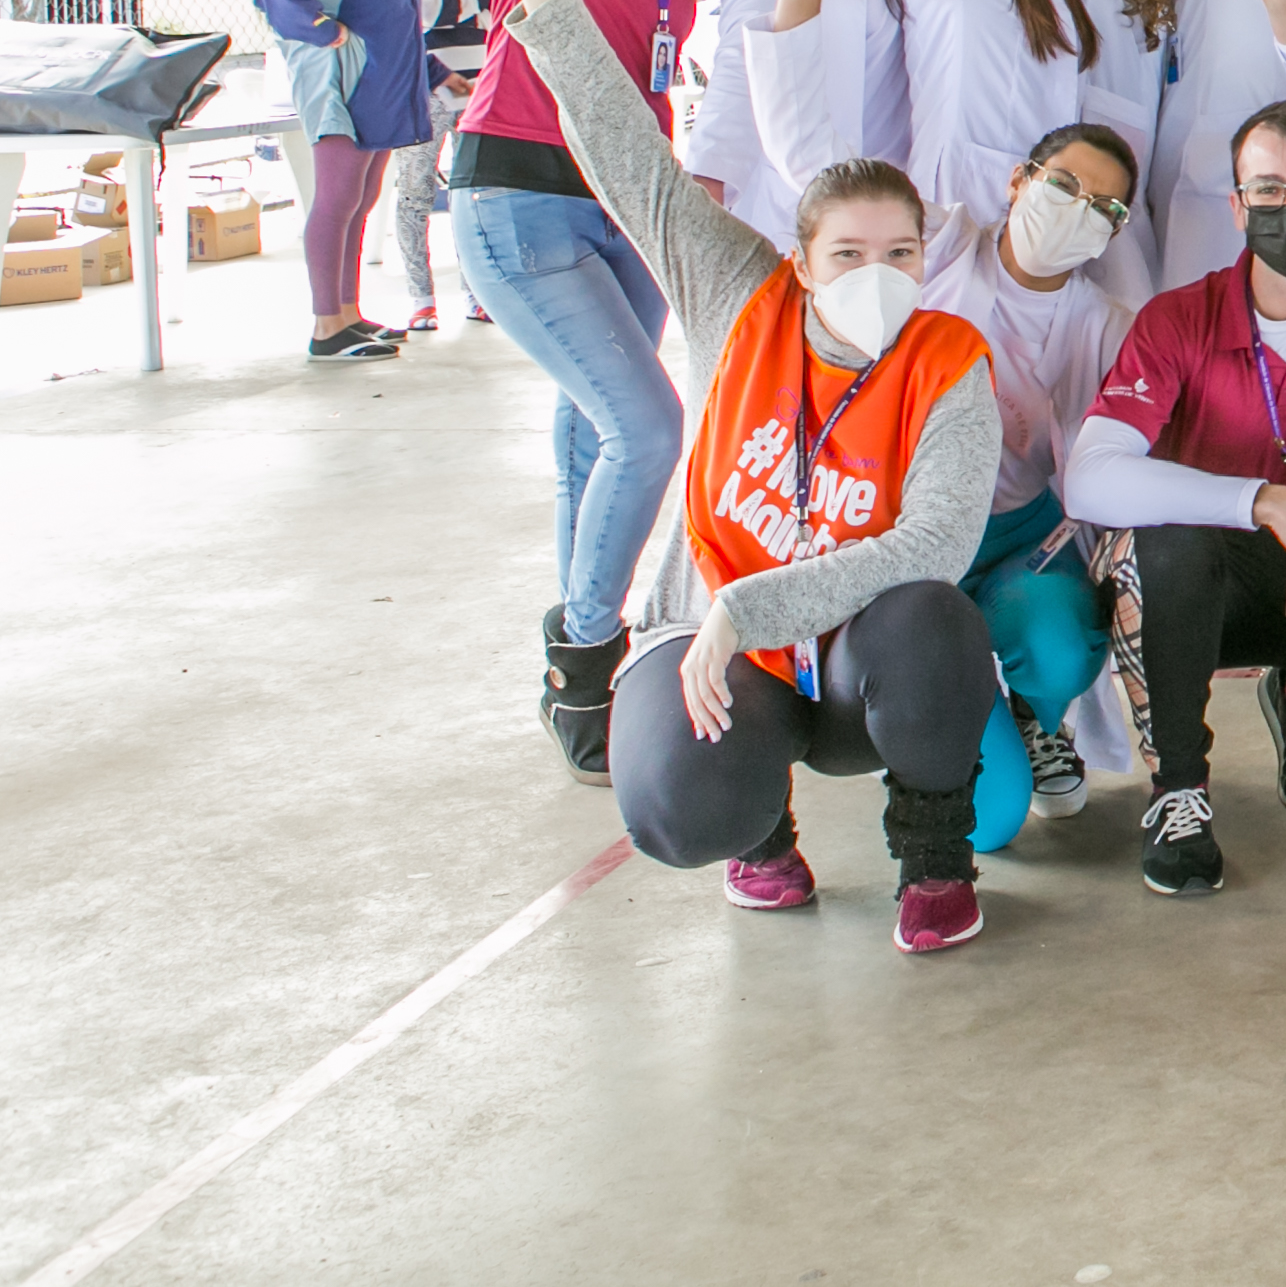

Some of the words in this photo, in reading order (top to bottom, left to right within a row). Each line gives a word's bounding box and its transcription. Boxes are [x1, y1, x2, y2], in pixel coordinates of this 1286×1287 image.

[16, 267, 38, 277] KLEY
[40, 264, 69, 274] HERTZ
[737, 418, 877, 527] #Move
